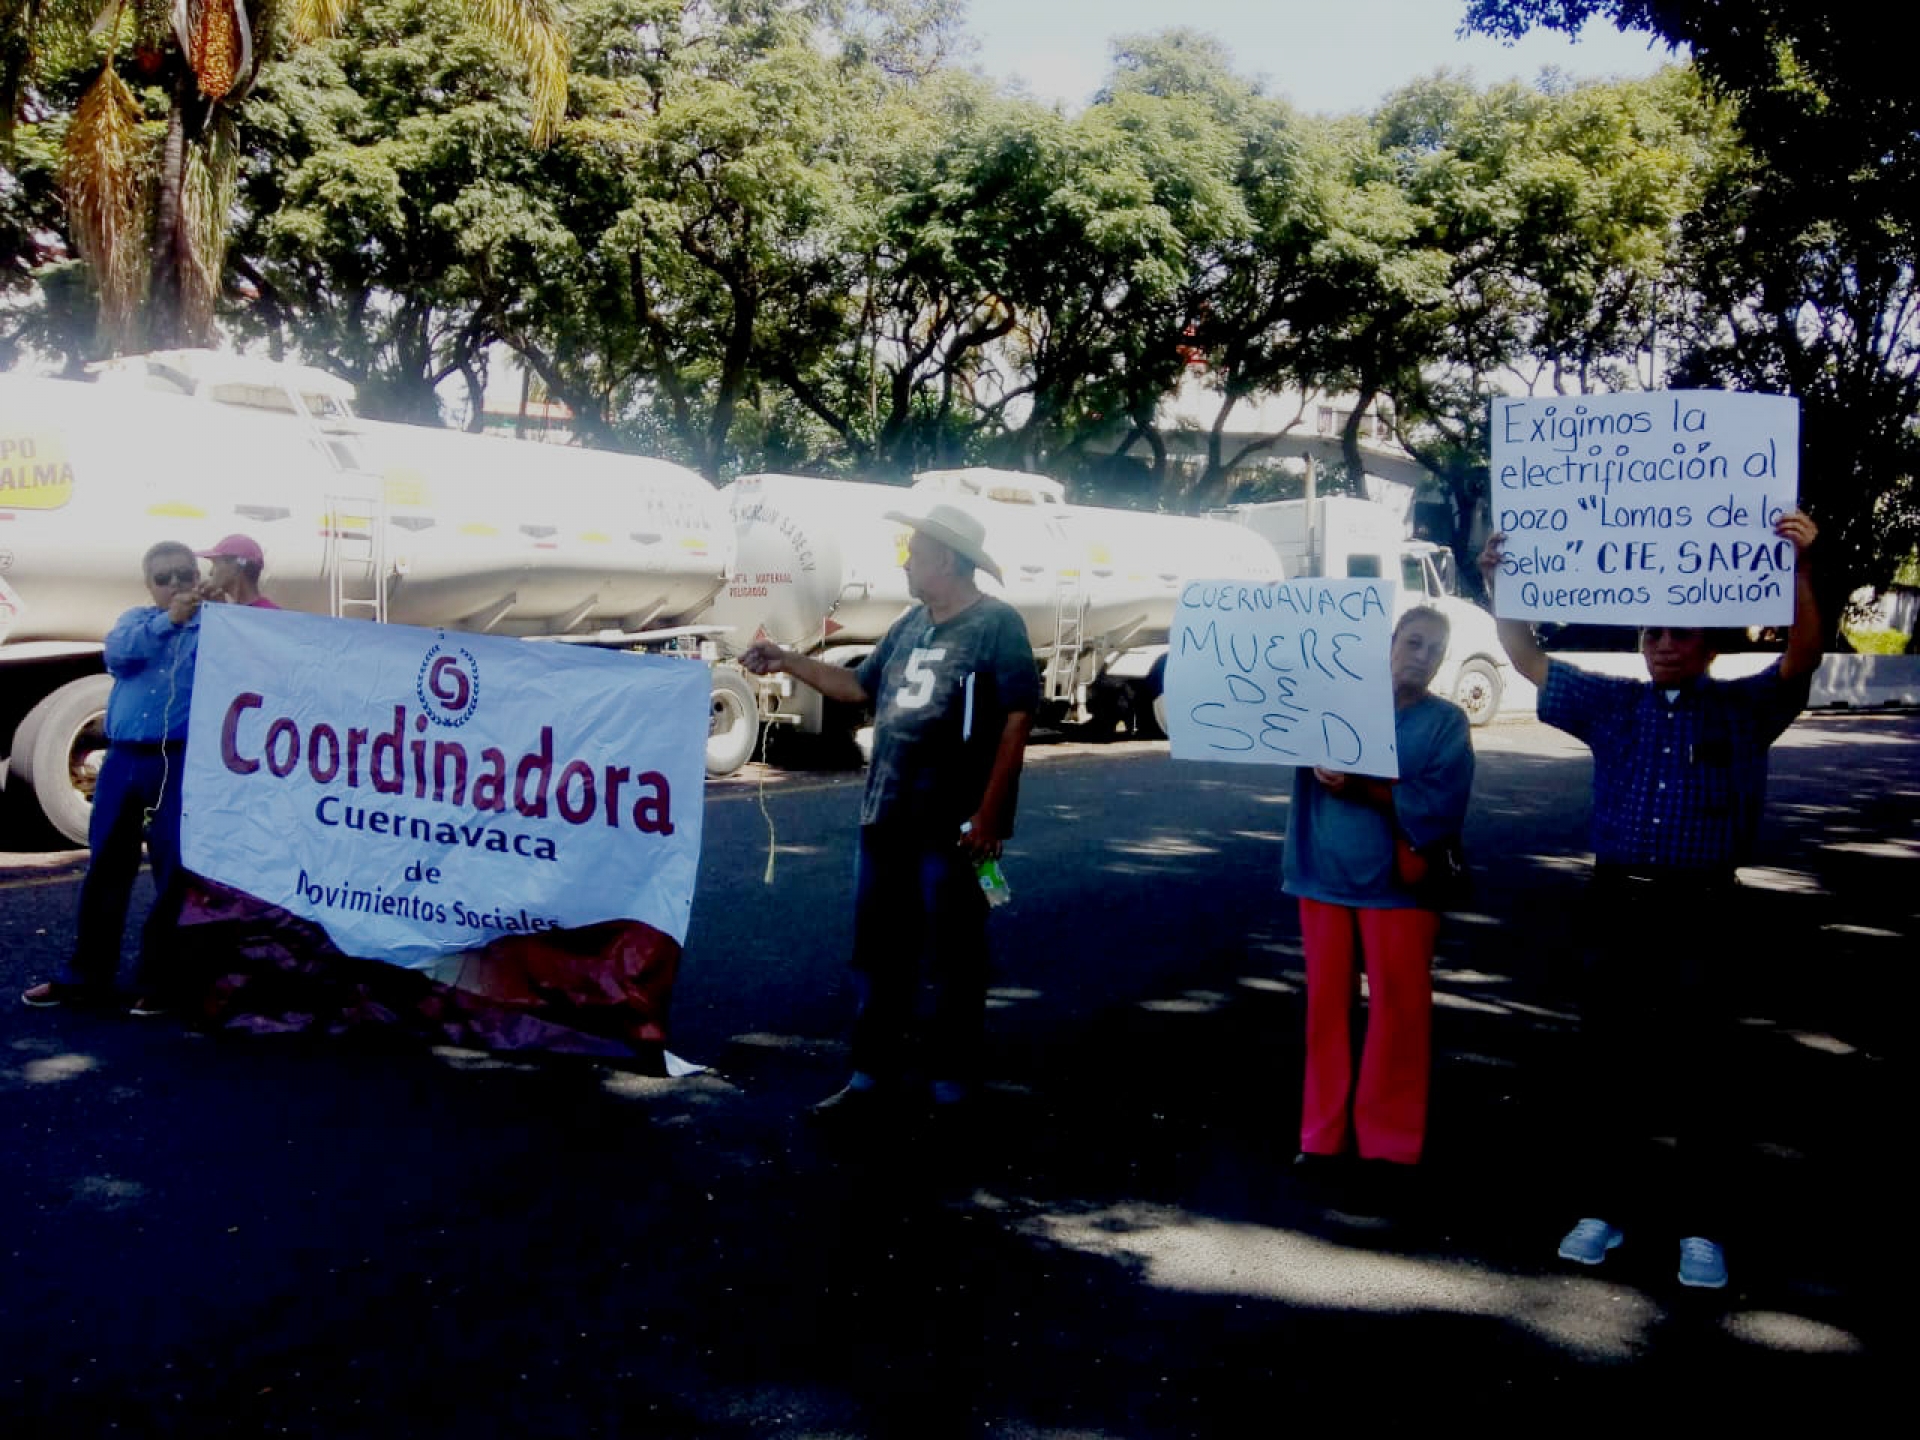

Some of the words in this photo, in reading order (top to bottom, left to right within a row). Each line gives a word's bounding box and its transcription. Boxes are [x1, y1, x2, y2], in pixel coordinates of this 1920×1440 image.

[1504, 402, 1652, 452] Exigimos
[1673, 398, 1706, 433] la
[1499, 441, 1728, 495] electrificación
[1742, 437, 1777, 479] al
[1500, 508, 1569, 533] pozo
[1705, 492, 1750, 529] de
[1677, 539, 1792, 574] SAPAC
[1182, 582, 1386, 622] CUERNAVACA
[1520, 581, 1651, 610] Queremos
[1667, 572, 1782, 605] solución
[1181, 619, 1364, 681] MUERE
[896, 648, 947, 709] 5
[1225, 674, 1309, 712] DE
[220, 691, 677, 837] Coordinadora
[315, 794, 559, 862] Cuernavaca
[404, 859, 442, 884] de
